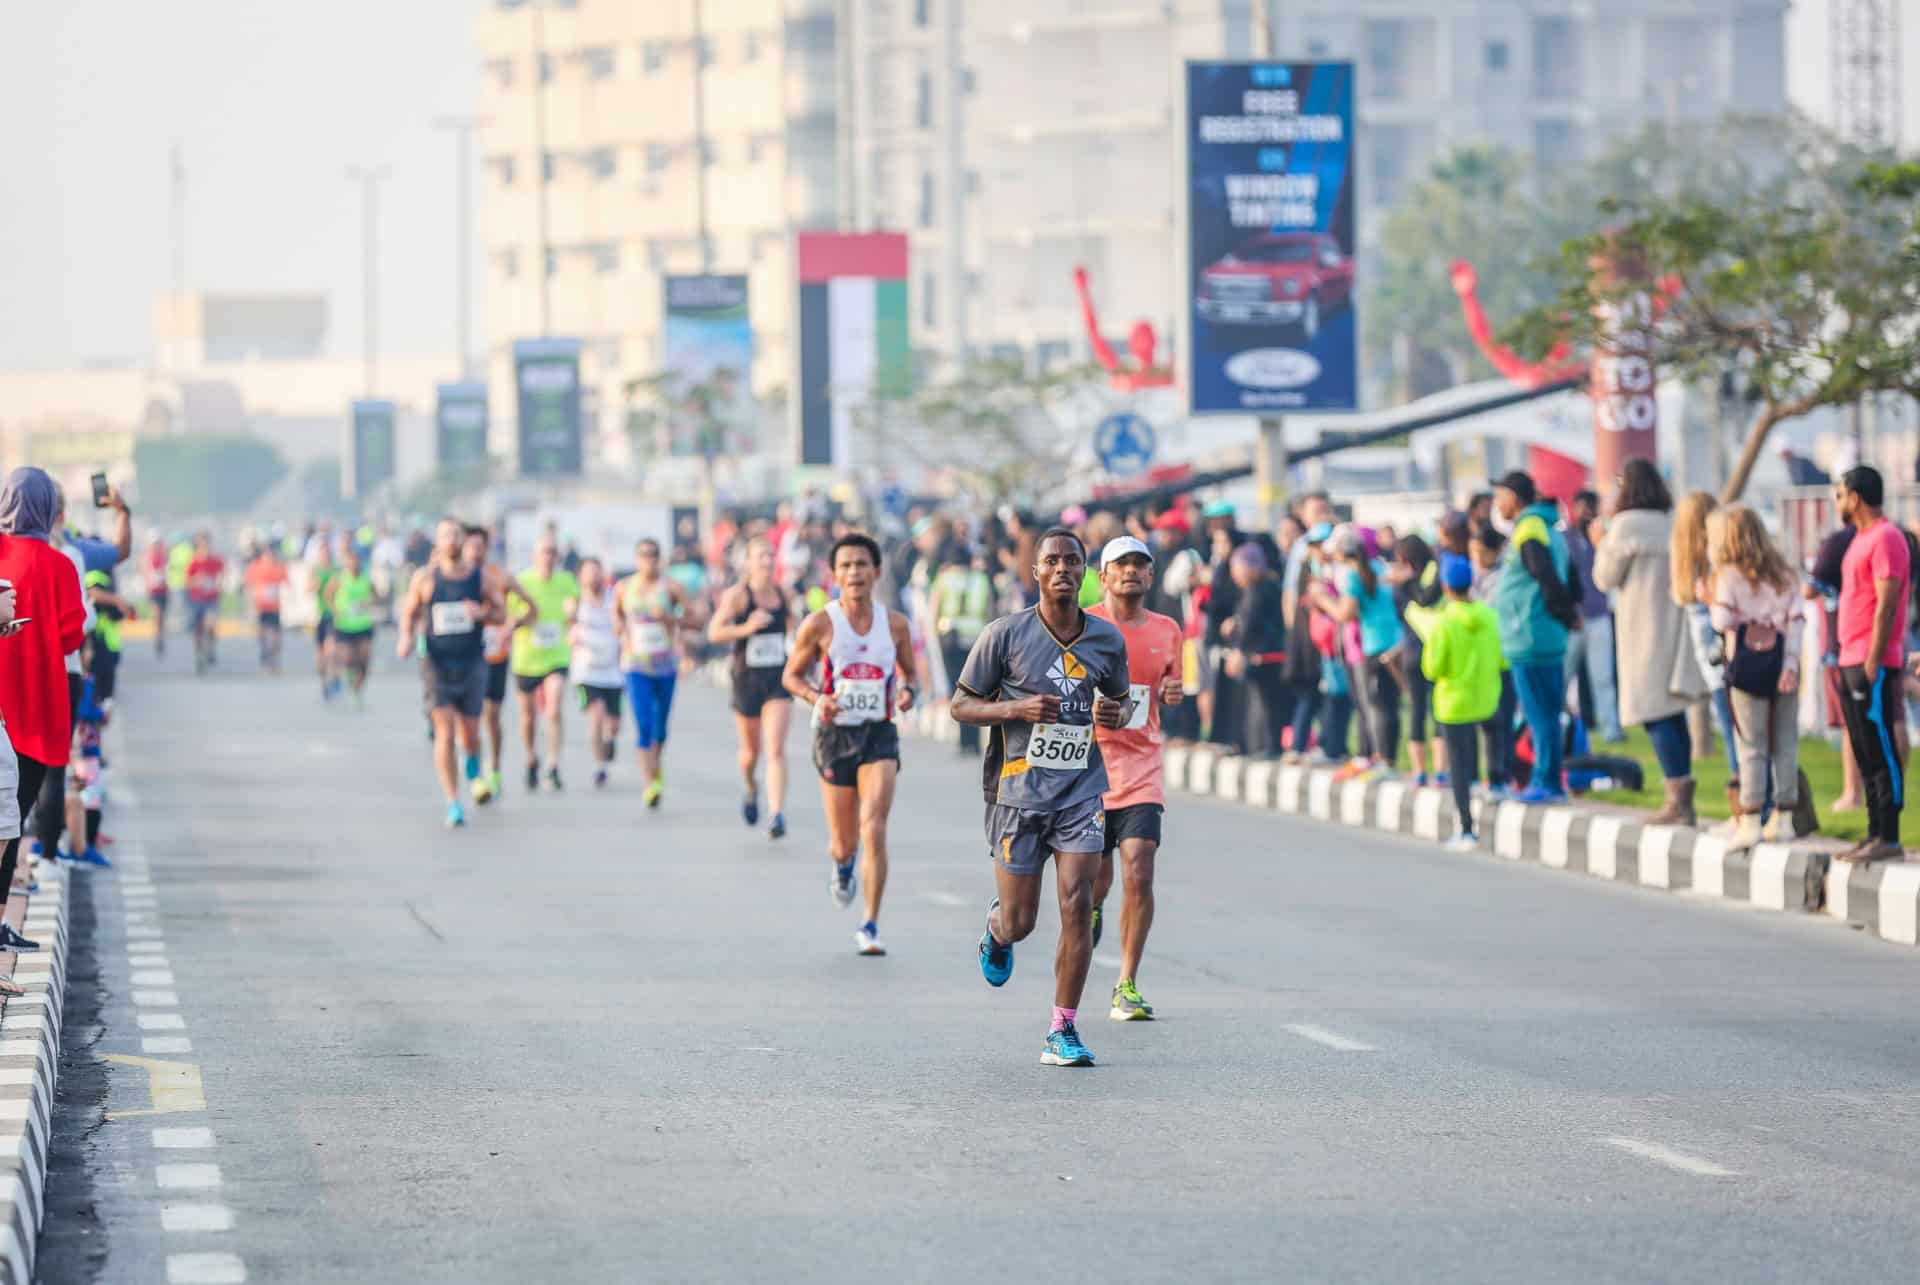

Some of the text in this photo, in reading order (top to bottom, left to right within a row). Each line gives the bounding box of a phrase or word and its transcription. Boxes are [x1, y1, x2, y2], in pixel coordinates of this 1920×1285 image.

[1599, 394, 1654, 432] GO
[846, 694, 880, 711] 382
[1031, 737, 1088, 762] 3506
